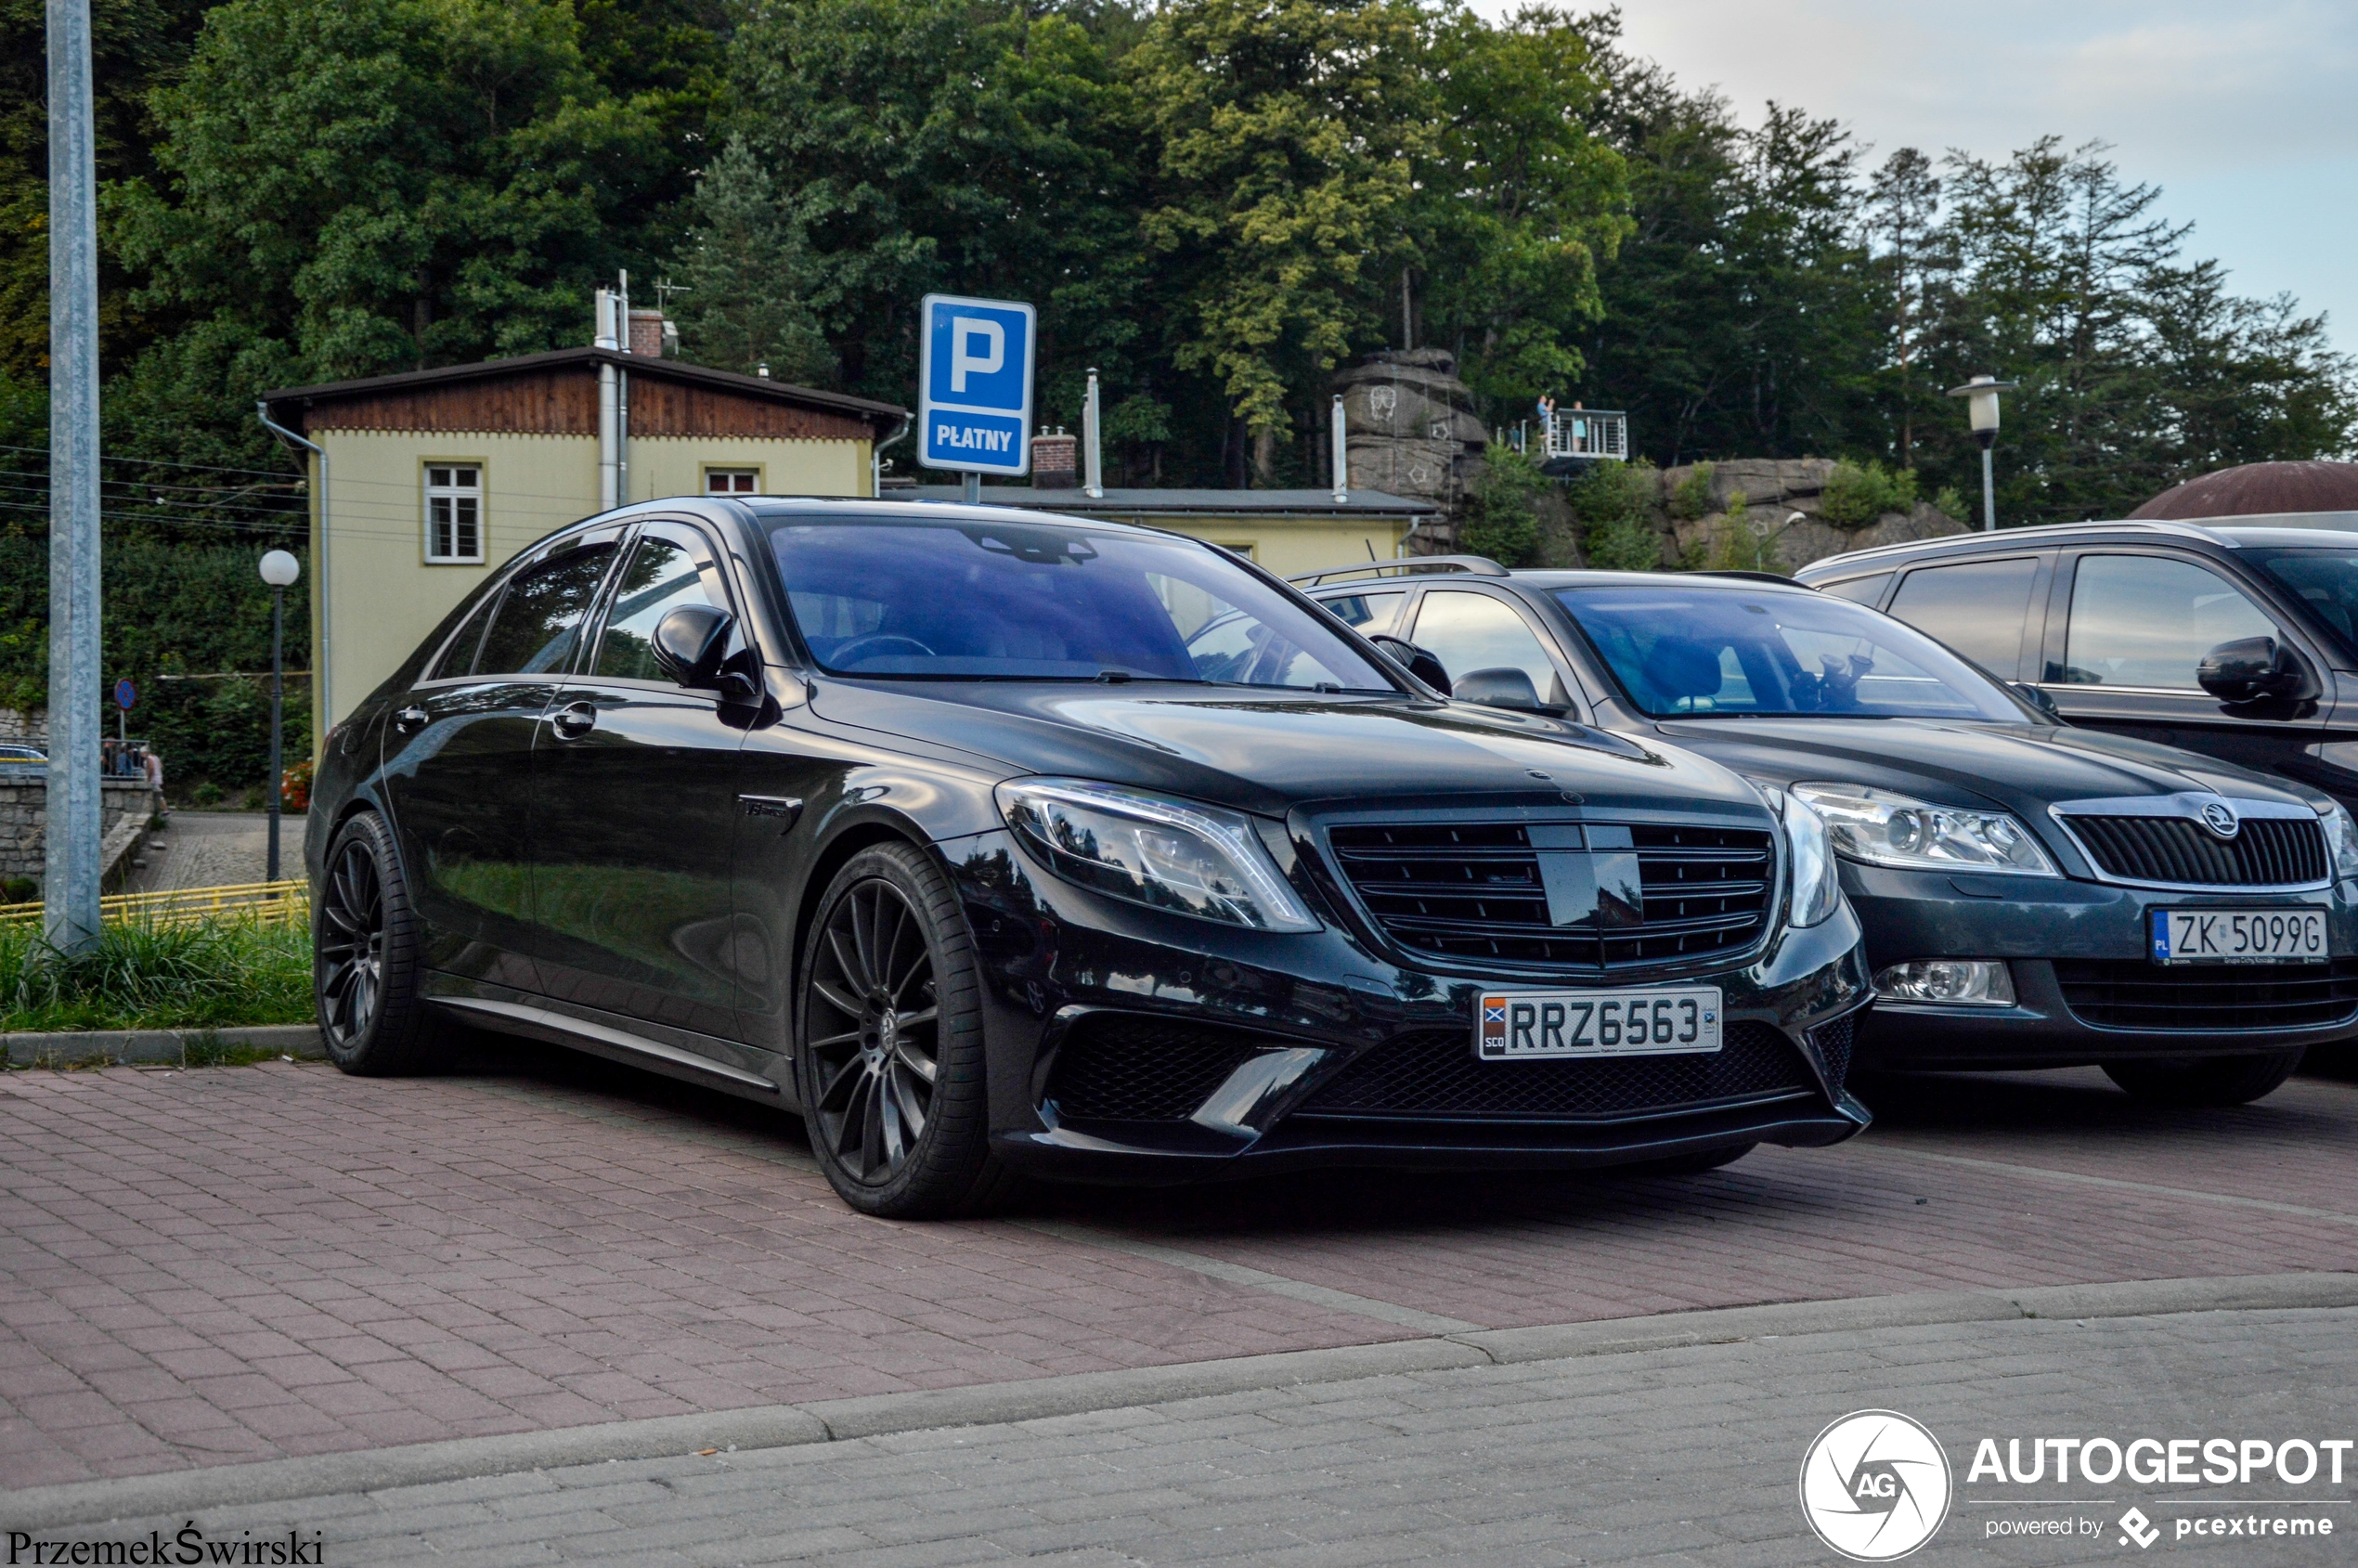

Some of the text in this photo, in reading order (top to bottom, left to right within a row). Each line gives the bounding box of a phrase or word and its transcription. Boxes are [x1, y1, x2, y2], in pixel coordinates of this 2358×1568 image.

[951, 316, 1005, 393] P
[937, 424, 1013, 452] PŁATNY
[2155, 940, 2169, 951] PL
[2176, 915, 2320, 953] ZK 5099G
[1510, 999, 1698, 1049] RRZ6563
[1485, 1037, 1504, 1047] SCO
